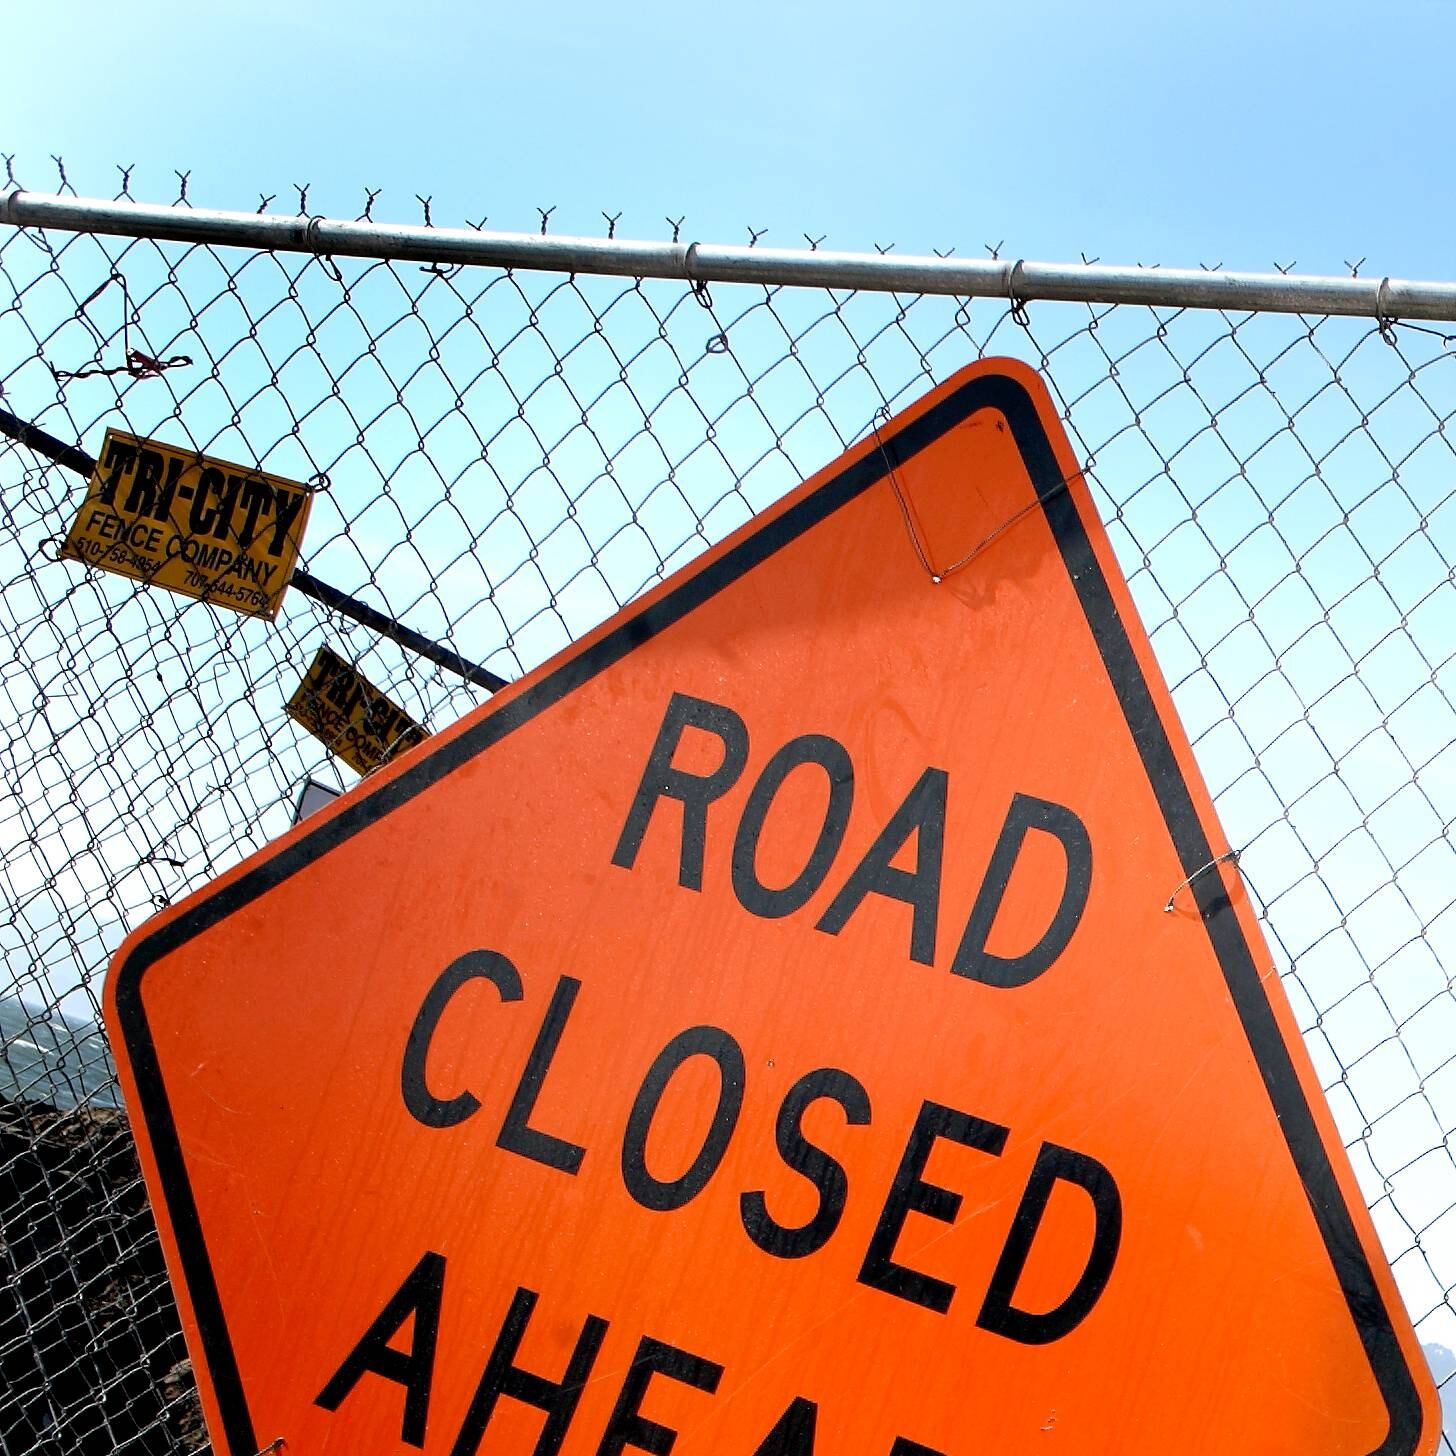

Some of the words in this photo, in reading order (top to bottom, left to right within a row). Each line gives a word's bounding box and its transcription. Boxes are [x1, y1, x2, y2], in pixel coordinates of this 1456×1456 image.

[85, 510, 164, 552] FENCE
[166, 534, 278, 586] COMPANY
[95, 440, 305, 557] TRI-CITY
[611, 692, 1092, 988] ROAD
[401, 949, 1122, 1345] CLOSED
